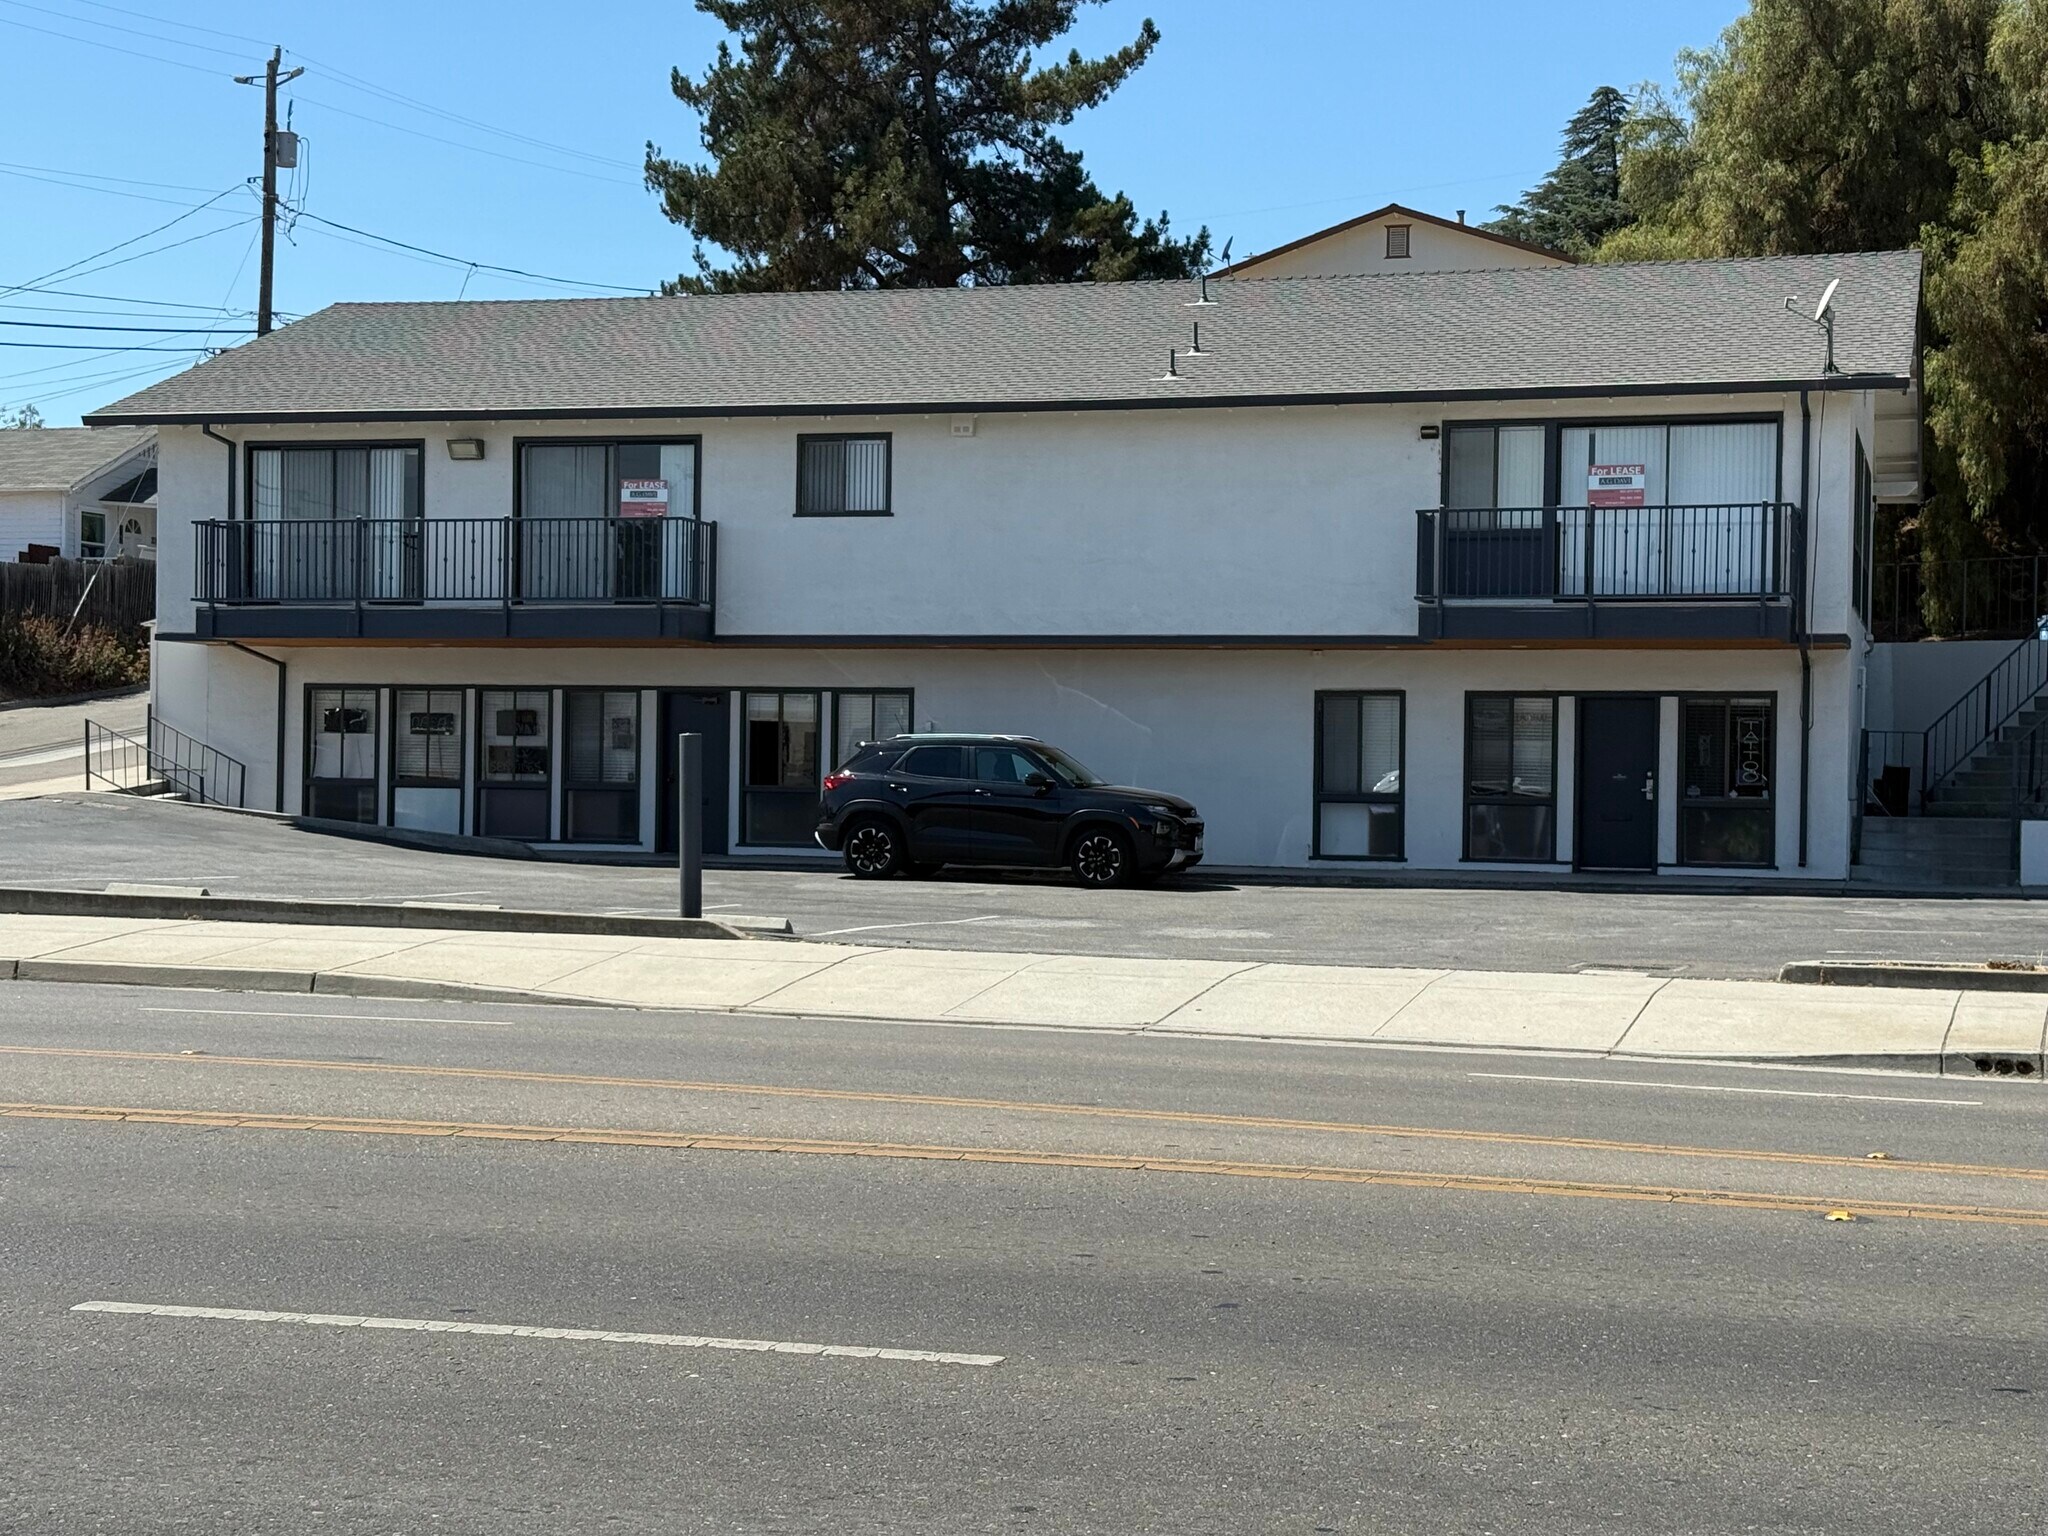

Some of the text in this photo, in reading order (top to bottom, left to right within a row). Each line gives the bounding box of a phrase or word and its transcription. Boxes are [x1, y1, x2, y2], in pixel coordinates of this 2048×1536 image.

[1591, 466, 1641, 476] For LEASE
[623, 481, 666, 489] For LEASE
[1742, 720, 1760, 783] TATTOO
